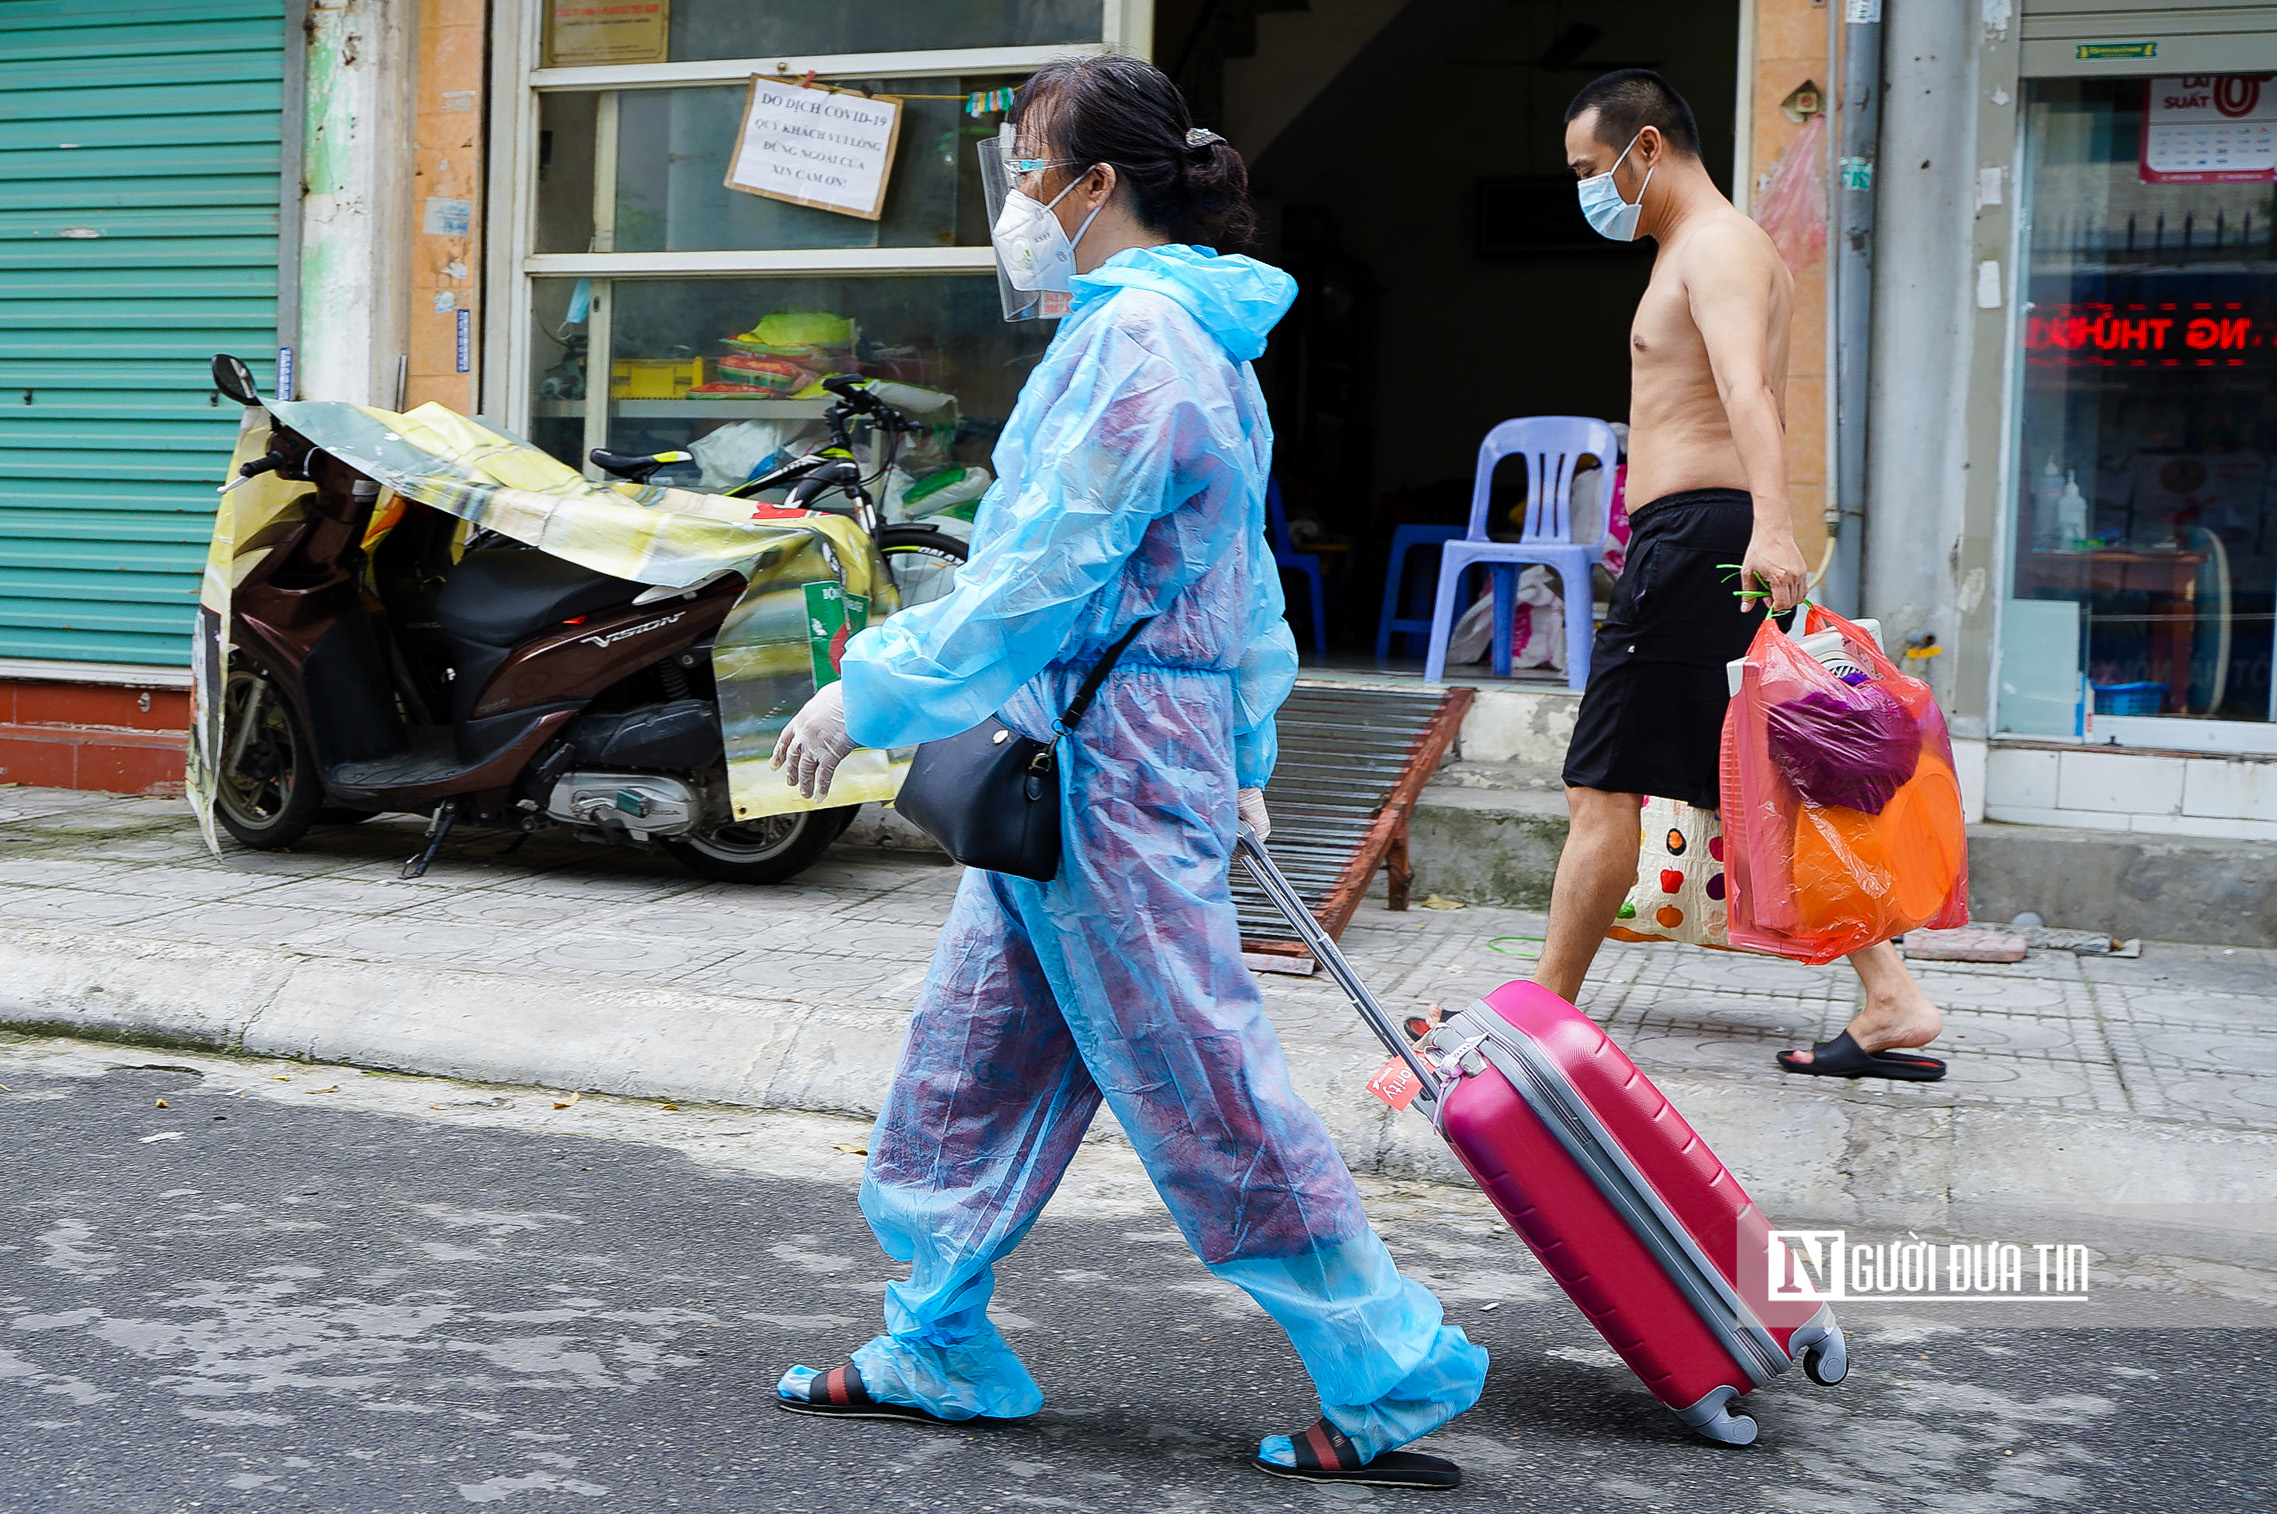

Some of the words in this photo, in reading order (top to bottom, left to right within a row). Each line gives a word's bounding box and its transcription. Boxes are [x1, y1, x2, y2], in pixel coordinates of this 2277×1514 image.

[761, 92, 783, 106] DO
[785, 97, 822, 114] DỊCH
[824, 105, 889, 127] COVID-19
[782, 123, 826, 141] KHÁCH
[771, 163, 793, 177] XIN
[579, 611, 687, 648] VISION
